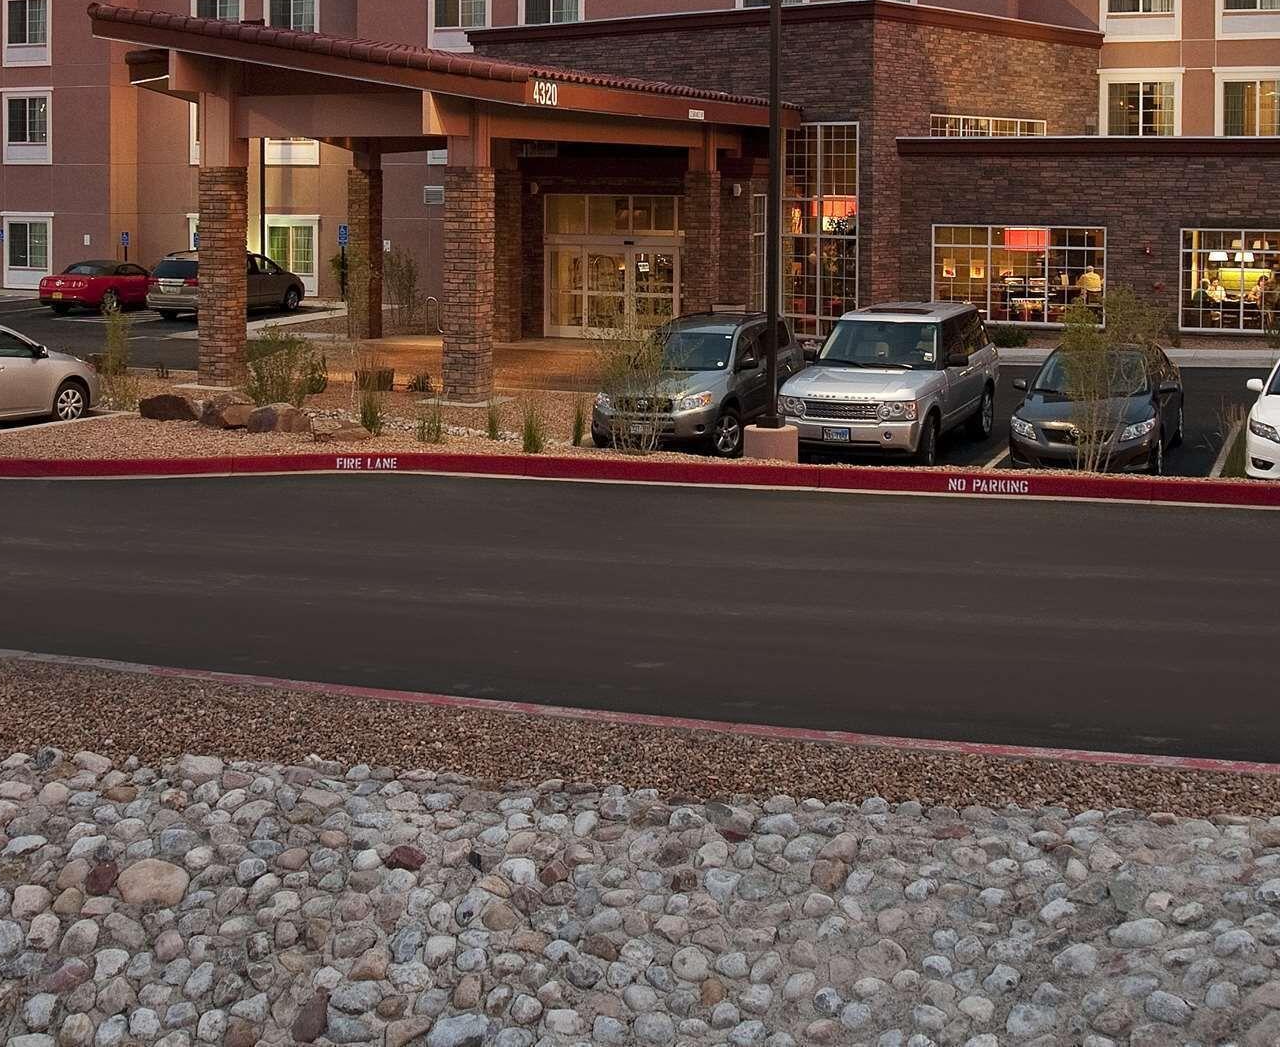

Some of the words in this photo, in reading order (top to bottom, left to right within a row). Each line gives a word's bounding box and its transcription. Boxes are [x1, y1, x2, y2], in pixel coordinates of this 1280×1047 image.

[532, 80, 558, 106] 4320
[336, 457, 362, 469] FIRE
[367, 457, 398, 469] LANE
[948, 477, 966, 491] NO
[972, 478, 1029, 493] PARKING
